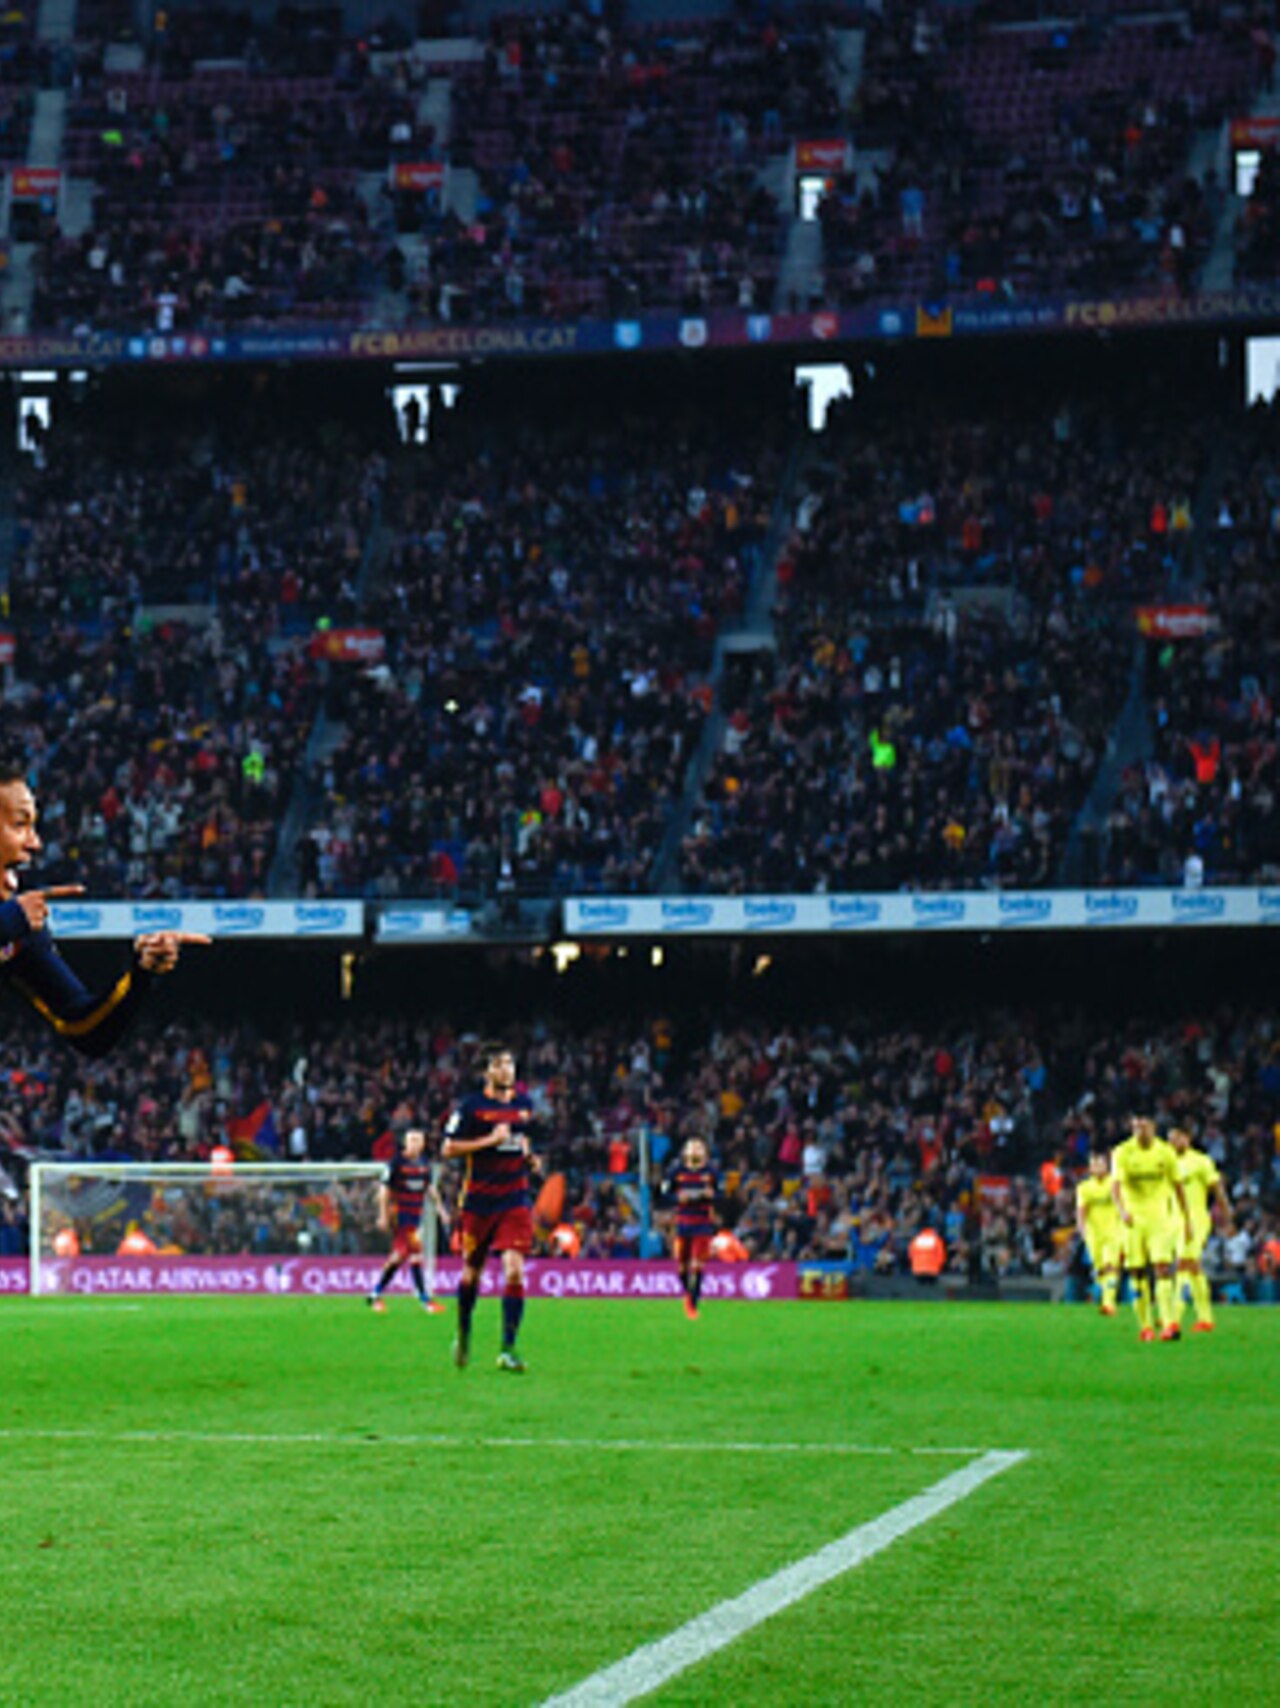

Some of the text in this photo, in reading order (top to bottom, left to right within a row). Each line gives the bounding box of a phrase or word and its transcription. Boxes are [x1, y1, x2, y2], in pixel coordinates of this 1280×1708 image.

[72, 1267, 259, 1292] QATAR AIRWAYS
[540, 1270, 624, 1297] QATAR
